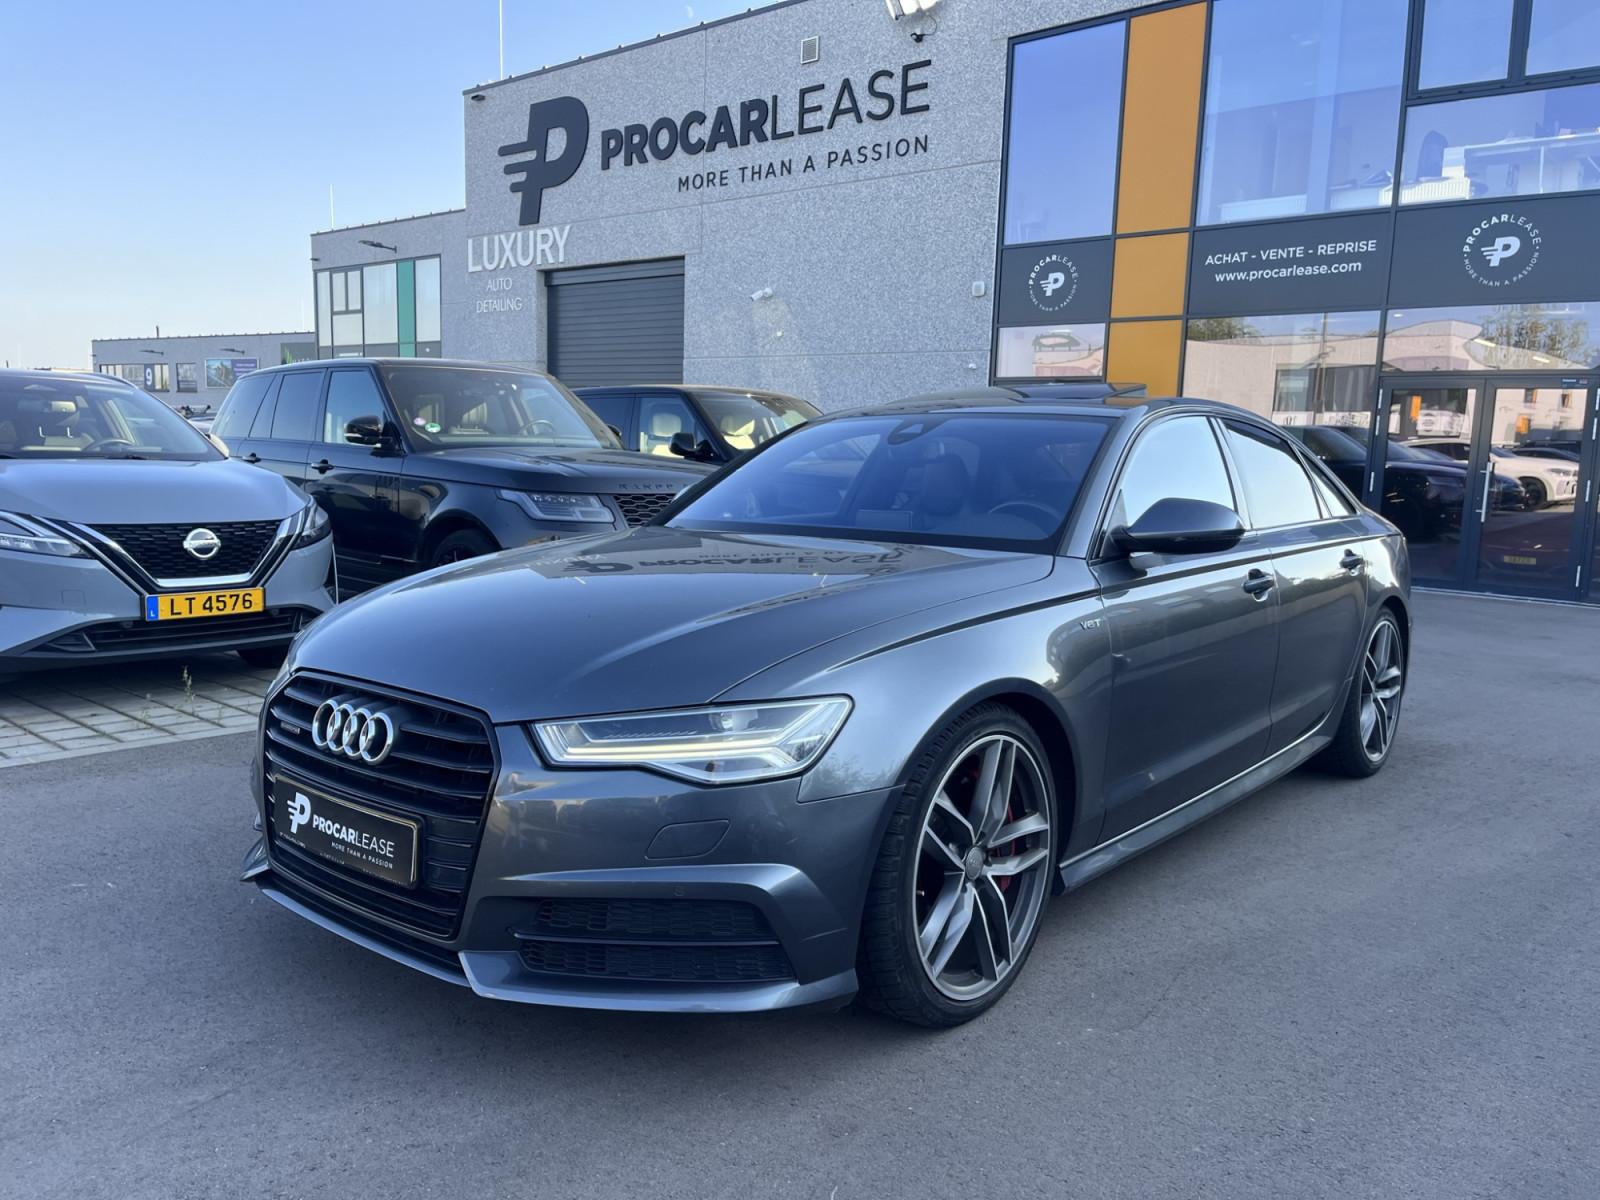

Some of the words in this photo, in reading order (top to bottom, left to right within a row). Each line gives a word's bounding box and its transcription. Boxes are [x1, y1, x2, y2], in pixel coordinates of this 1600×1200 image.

[601, 59, 932, 171] PROCARLEASE
[678, 170, 729, 192] MORE
[739, 159, 793, 183] THAN
[803, 155, 816, 173] A
[827, 134, 929, 169] PASSION
[1463, 213, 1541, 252] PROCARLEASE
[466, 225, 572, 273] LUXURY
[1205, 252, 1248, 266] ACHAT
[1260, 246, 1305, 260] VENTE
[1317, 239, 1377, 256] REPRISE
[487, 277, 513, 292] AUTO
[1215, 261, 1362, 282] www.procarlease.com
[476, 297, 522, 313] DETAILING
[145, 367, 153, 386] 9
[170, 597, 197, 616] LT
[202, 592, 253, 613] 4576
[312, 814, 395, 858] PROCARLEASE
